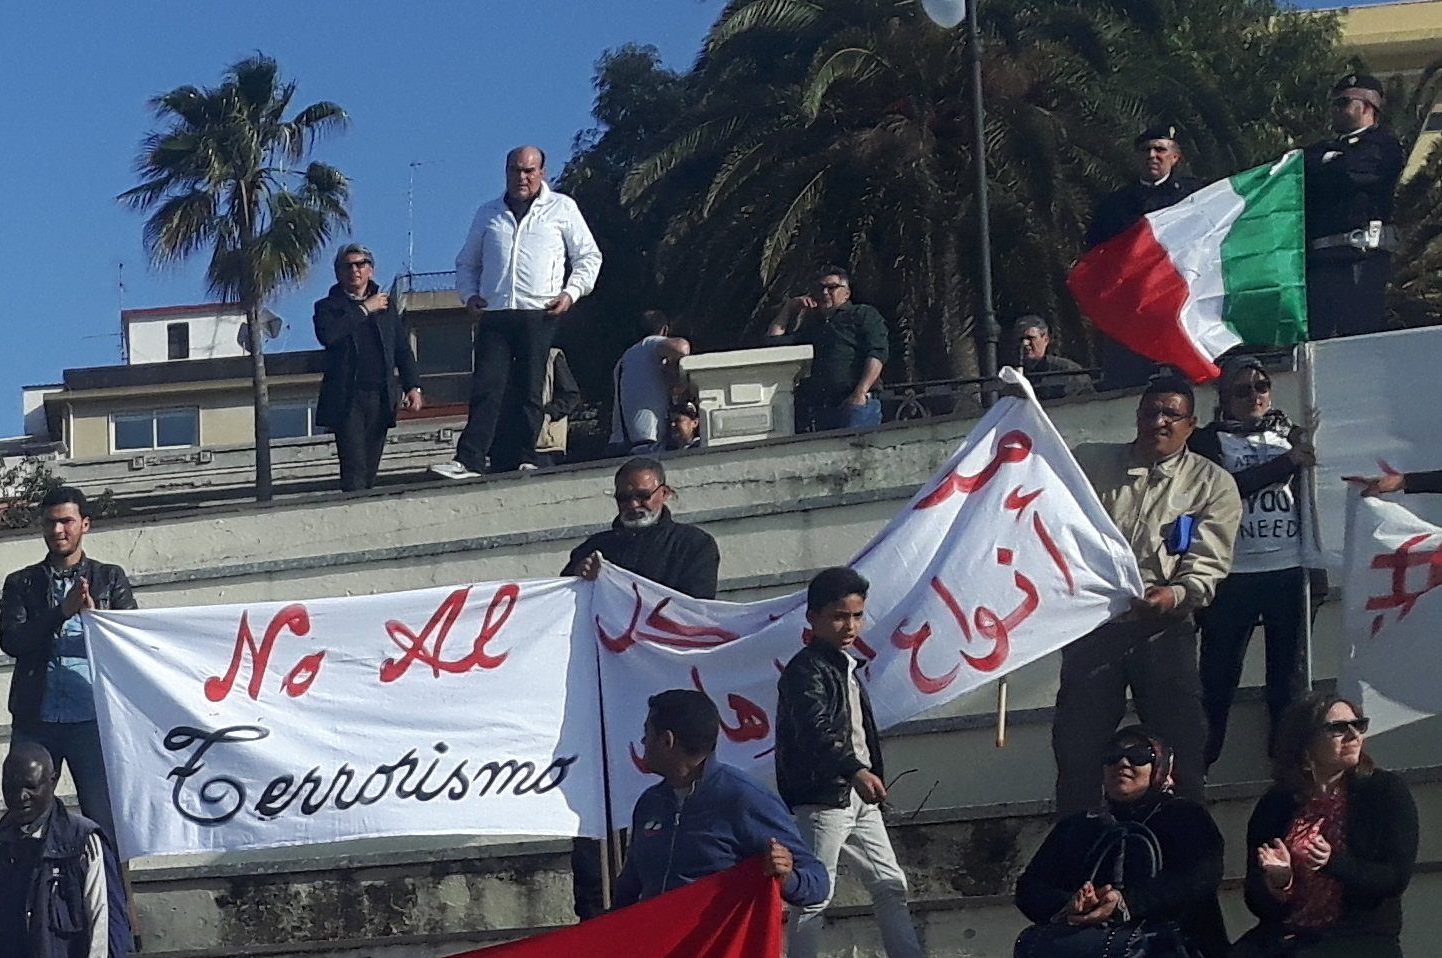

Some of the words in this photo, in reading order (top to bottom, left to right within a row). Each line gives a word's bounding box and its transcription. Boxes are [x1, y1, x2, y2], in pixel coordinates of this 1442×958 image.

[1239, 519, 1298, 538] NEED
[203, 604, 328, 702] No
[379, 583, 521, 683] Al
[162, 725, 579, 827] Terrorismo
